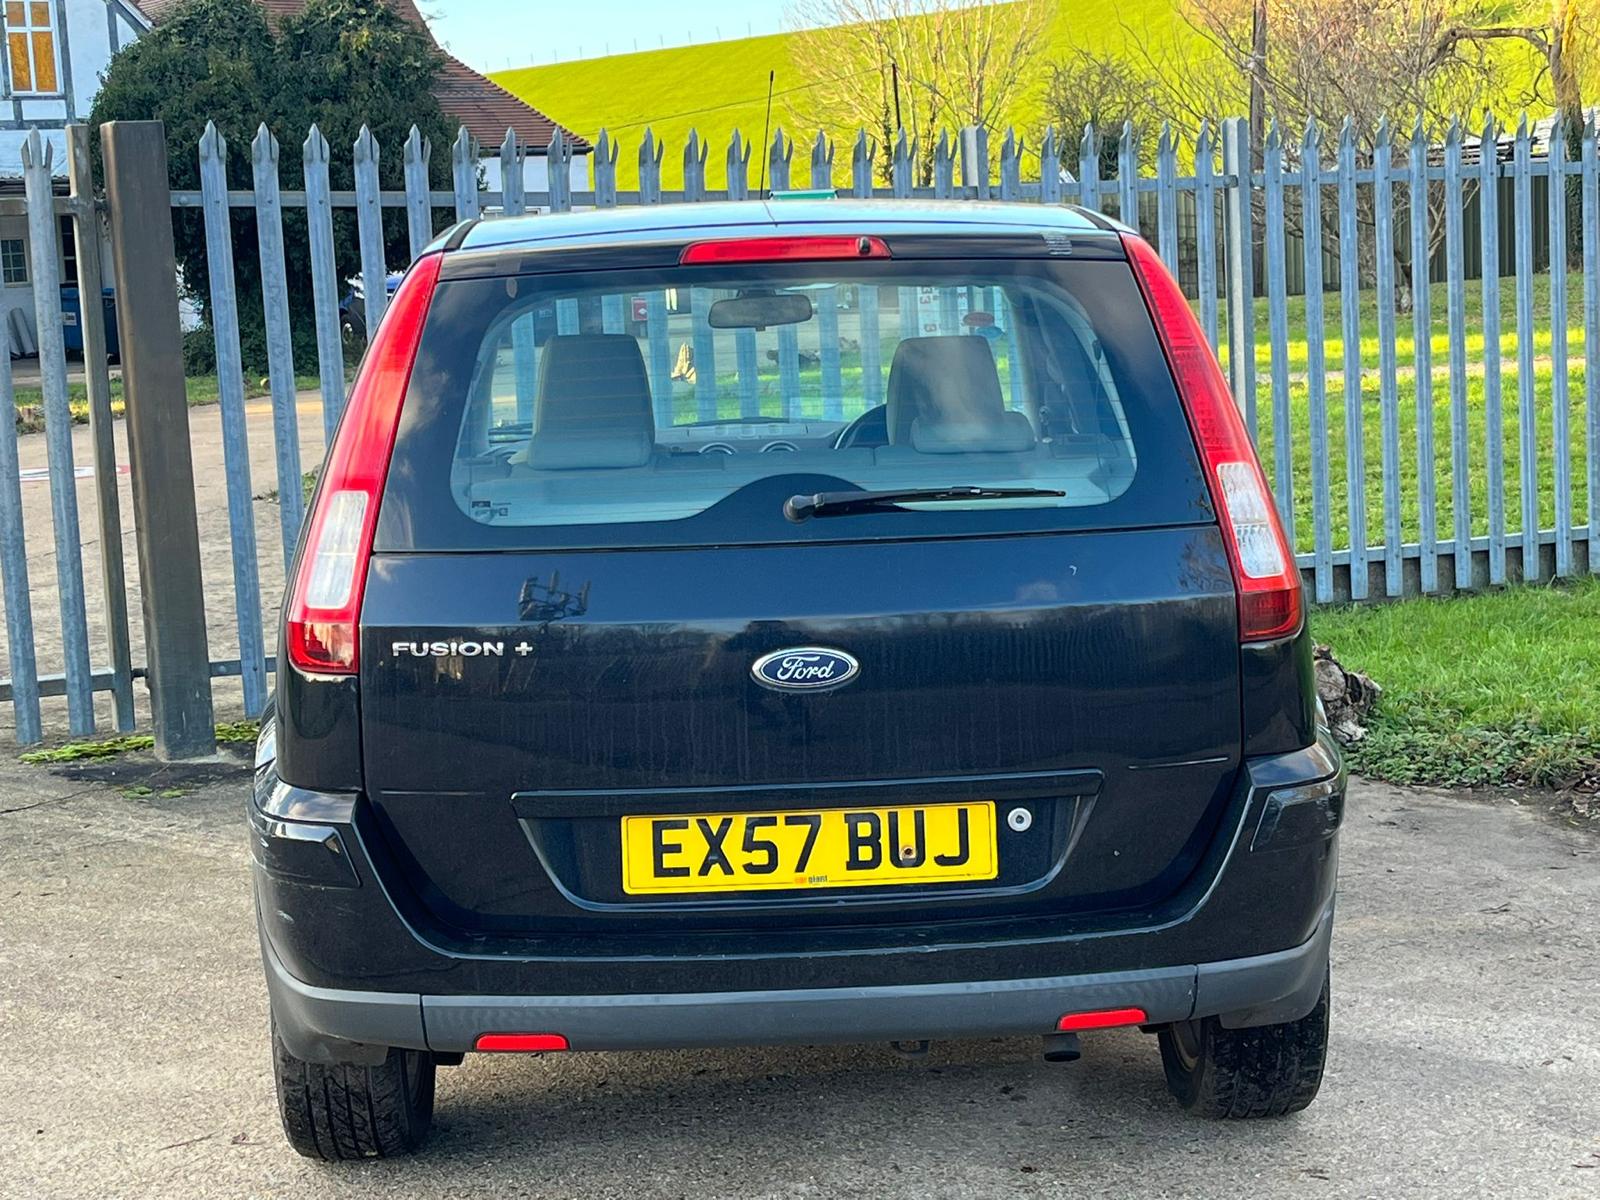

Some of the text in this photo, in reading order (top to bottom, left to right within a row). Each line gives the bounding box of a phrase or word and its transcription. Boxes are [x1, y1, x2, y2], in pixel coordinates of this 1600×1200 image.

[392, 642, 504, 657] FUSION
[777, 656, 835, 680] Ford
[652, 808, 970, 878] EX57 BUJ
